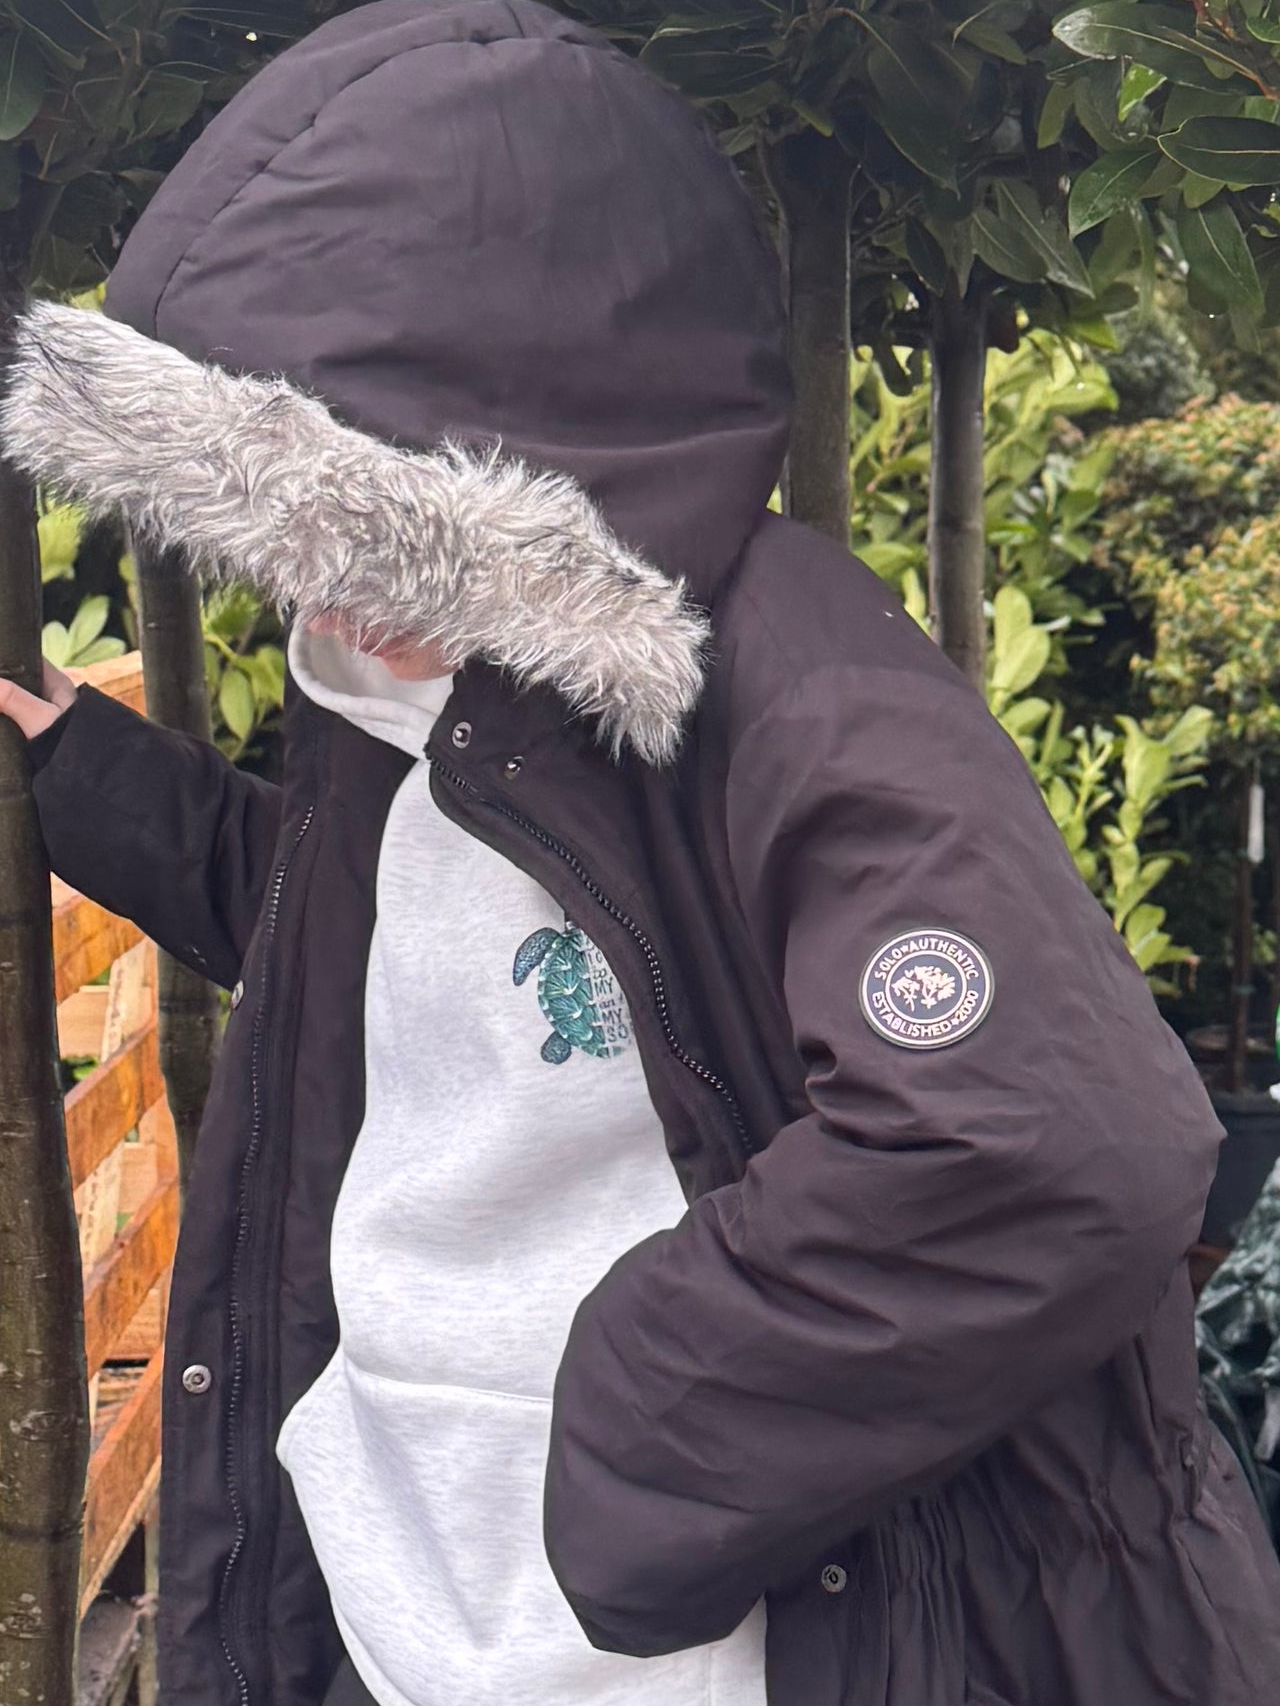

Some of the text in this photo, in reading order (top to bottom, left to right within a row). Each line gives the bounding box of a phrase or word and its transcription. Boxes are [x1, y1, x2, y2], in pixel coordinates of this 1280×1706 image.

[874, 938, 979, 981] SOLO AUTHENTIC
[872, 990, 979, 1037] ESTABLISHED 2000
